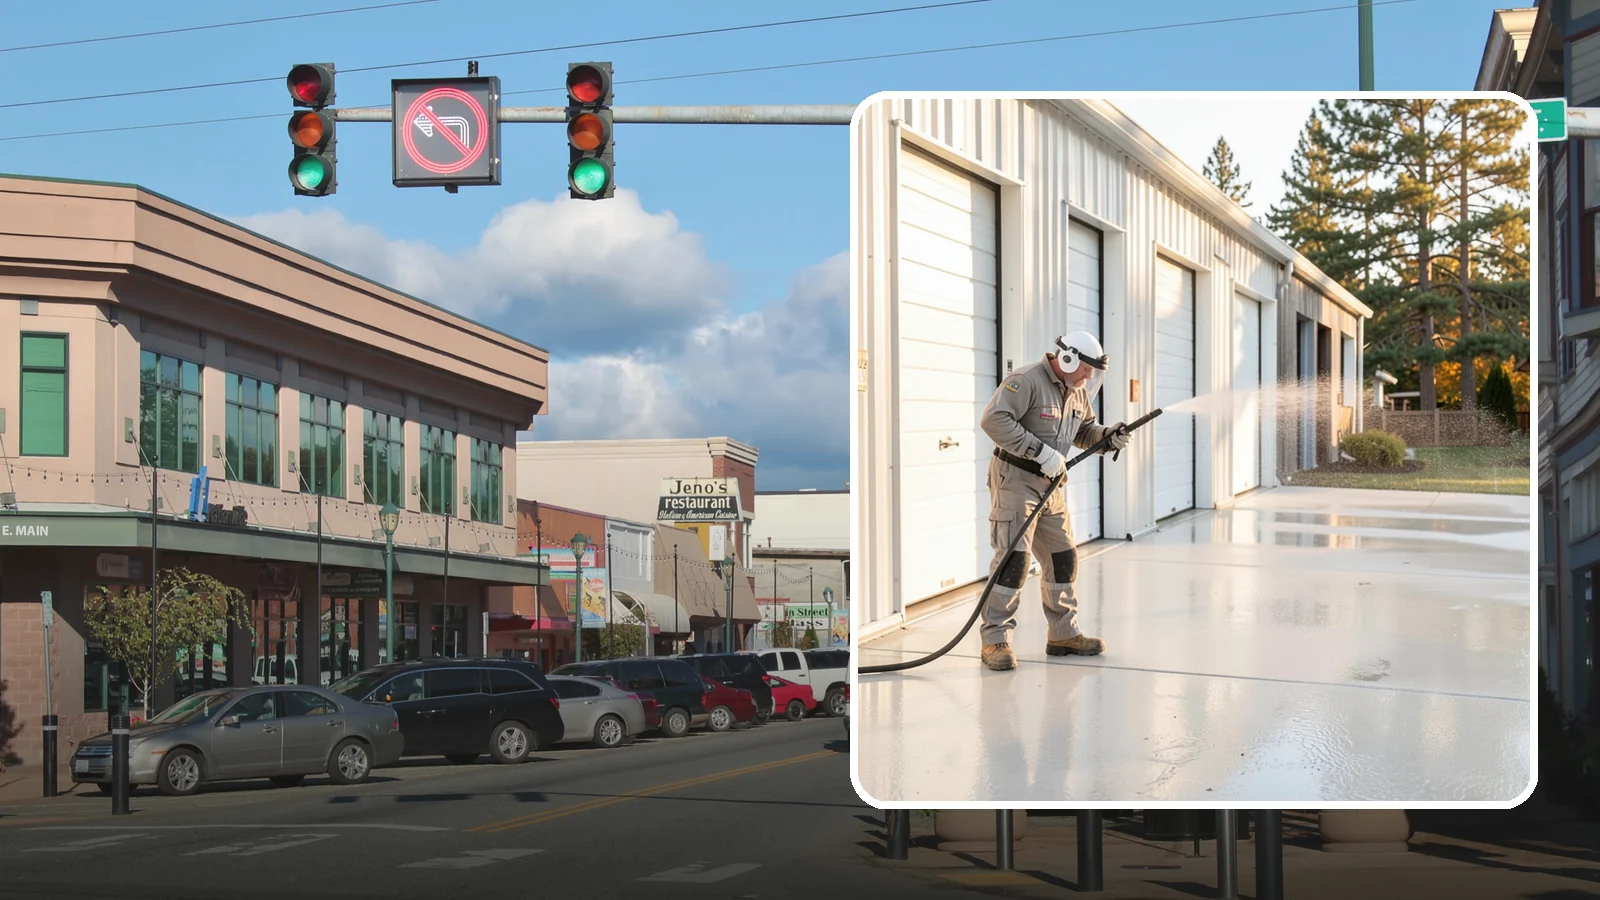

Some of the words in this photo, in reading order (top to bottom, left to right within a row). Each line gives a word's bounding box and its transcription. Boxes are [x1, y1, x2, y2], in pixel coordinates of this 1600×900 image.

[669, 479, 728, 495] Jeno's
[665, 496, 731, 509] restaurant
[658, 510, 682, 520] Italian
[686, 510, 714, 519] American
[715, 509, 738, 519] Cuisine
[2, 525, 13, 536] E.
[15, 525, 49, 537] MAIN
[785, 607, 795, 617] in
[797, 607, 829, 617] Street
